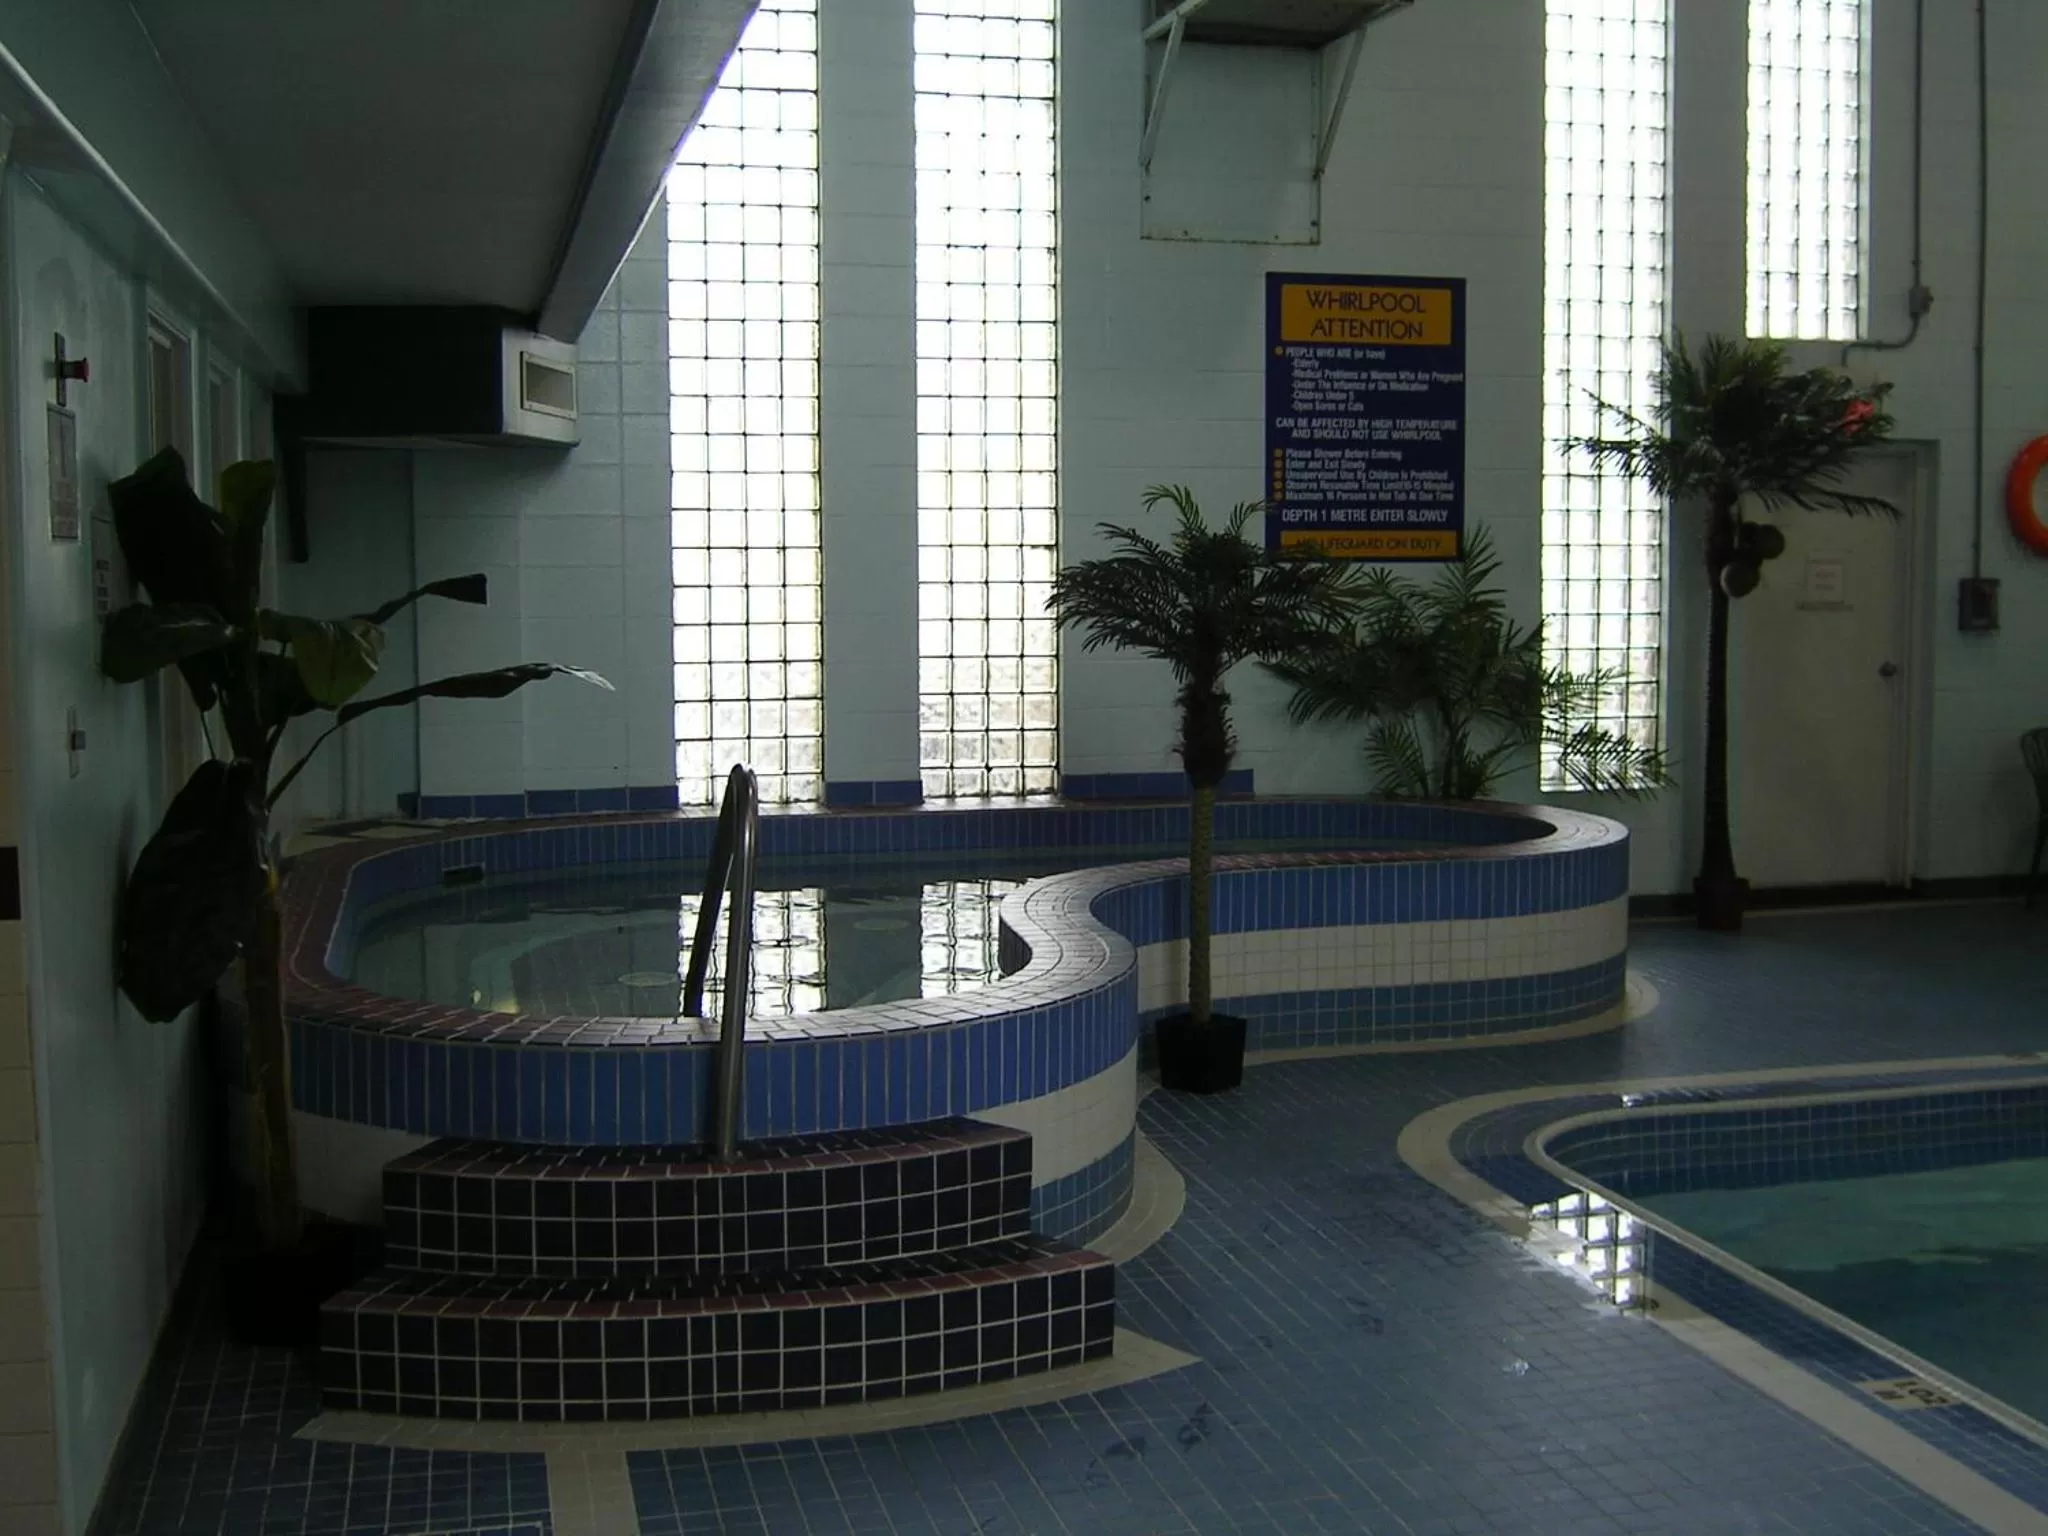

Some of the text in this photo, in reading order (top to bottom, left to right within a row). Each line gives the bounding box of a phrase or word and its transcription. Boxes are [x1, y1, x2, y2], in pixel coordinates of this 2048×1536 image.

[1306, 288, 1426, 314] WHIRLPOOL
[1310, 317, 1423, 340] ATTENTION
[1286, 347, 1314, 358] PEOPLE
[1316, 348, 1335, 359] WHO
[1336, 348, 1352, 359] ARE
[1275, 417, 1457, 431] CAN BE AFFECTED BY HIGH TEMPERATURE
[1292, 428, 1442, 442] AND SHOULD NOT USE WHIRLPOOL
[1281, 508, 1448, 523] DEPTH 1 METRE ENTER SLOWLY
[1320, 536, 1384, 551] LIFEGUARD
[1387, 537, 1409, 551] ON
[1410, 536, 1441, 552] DUTY
